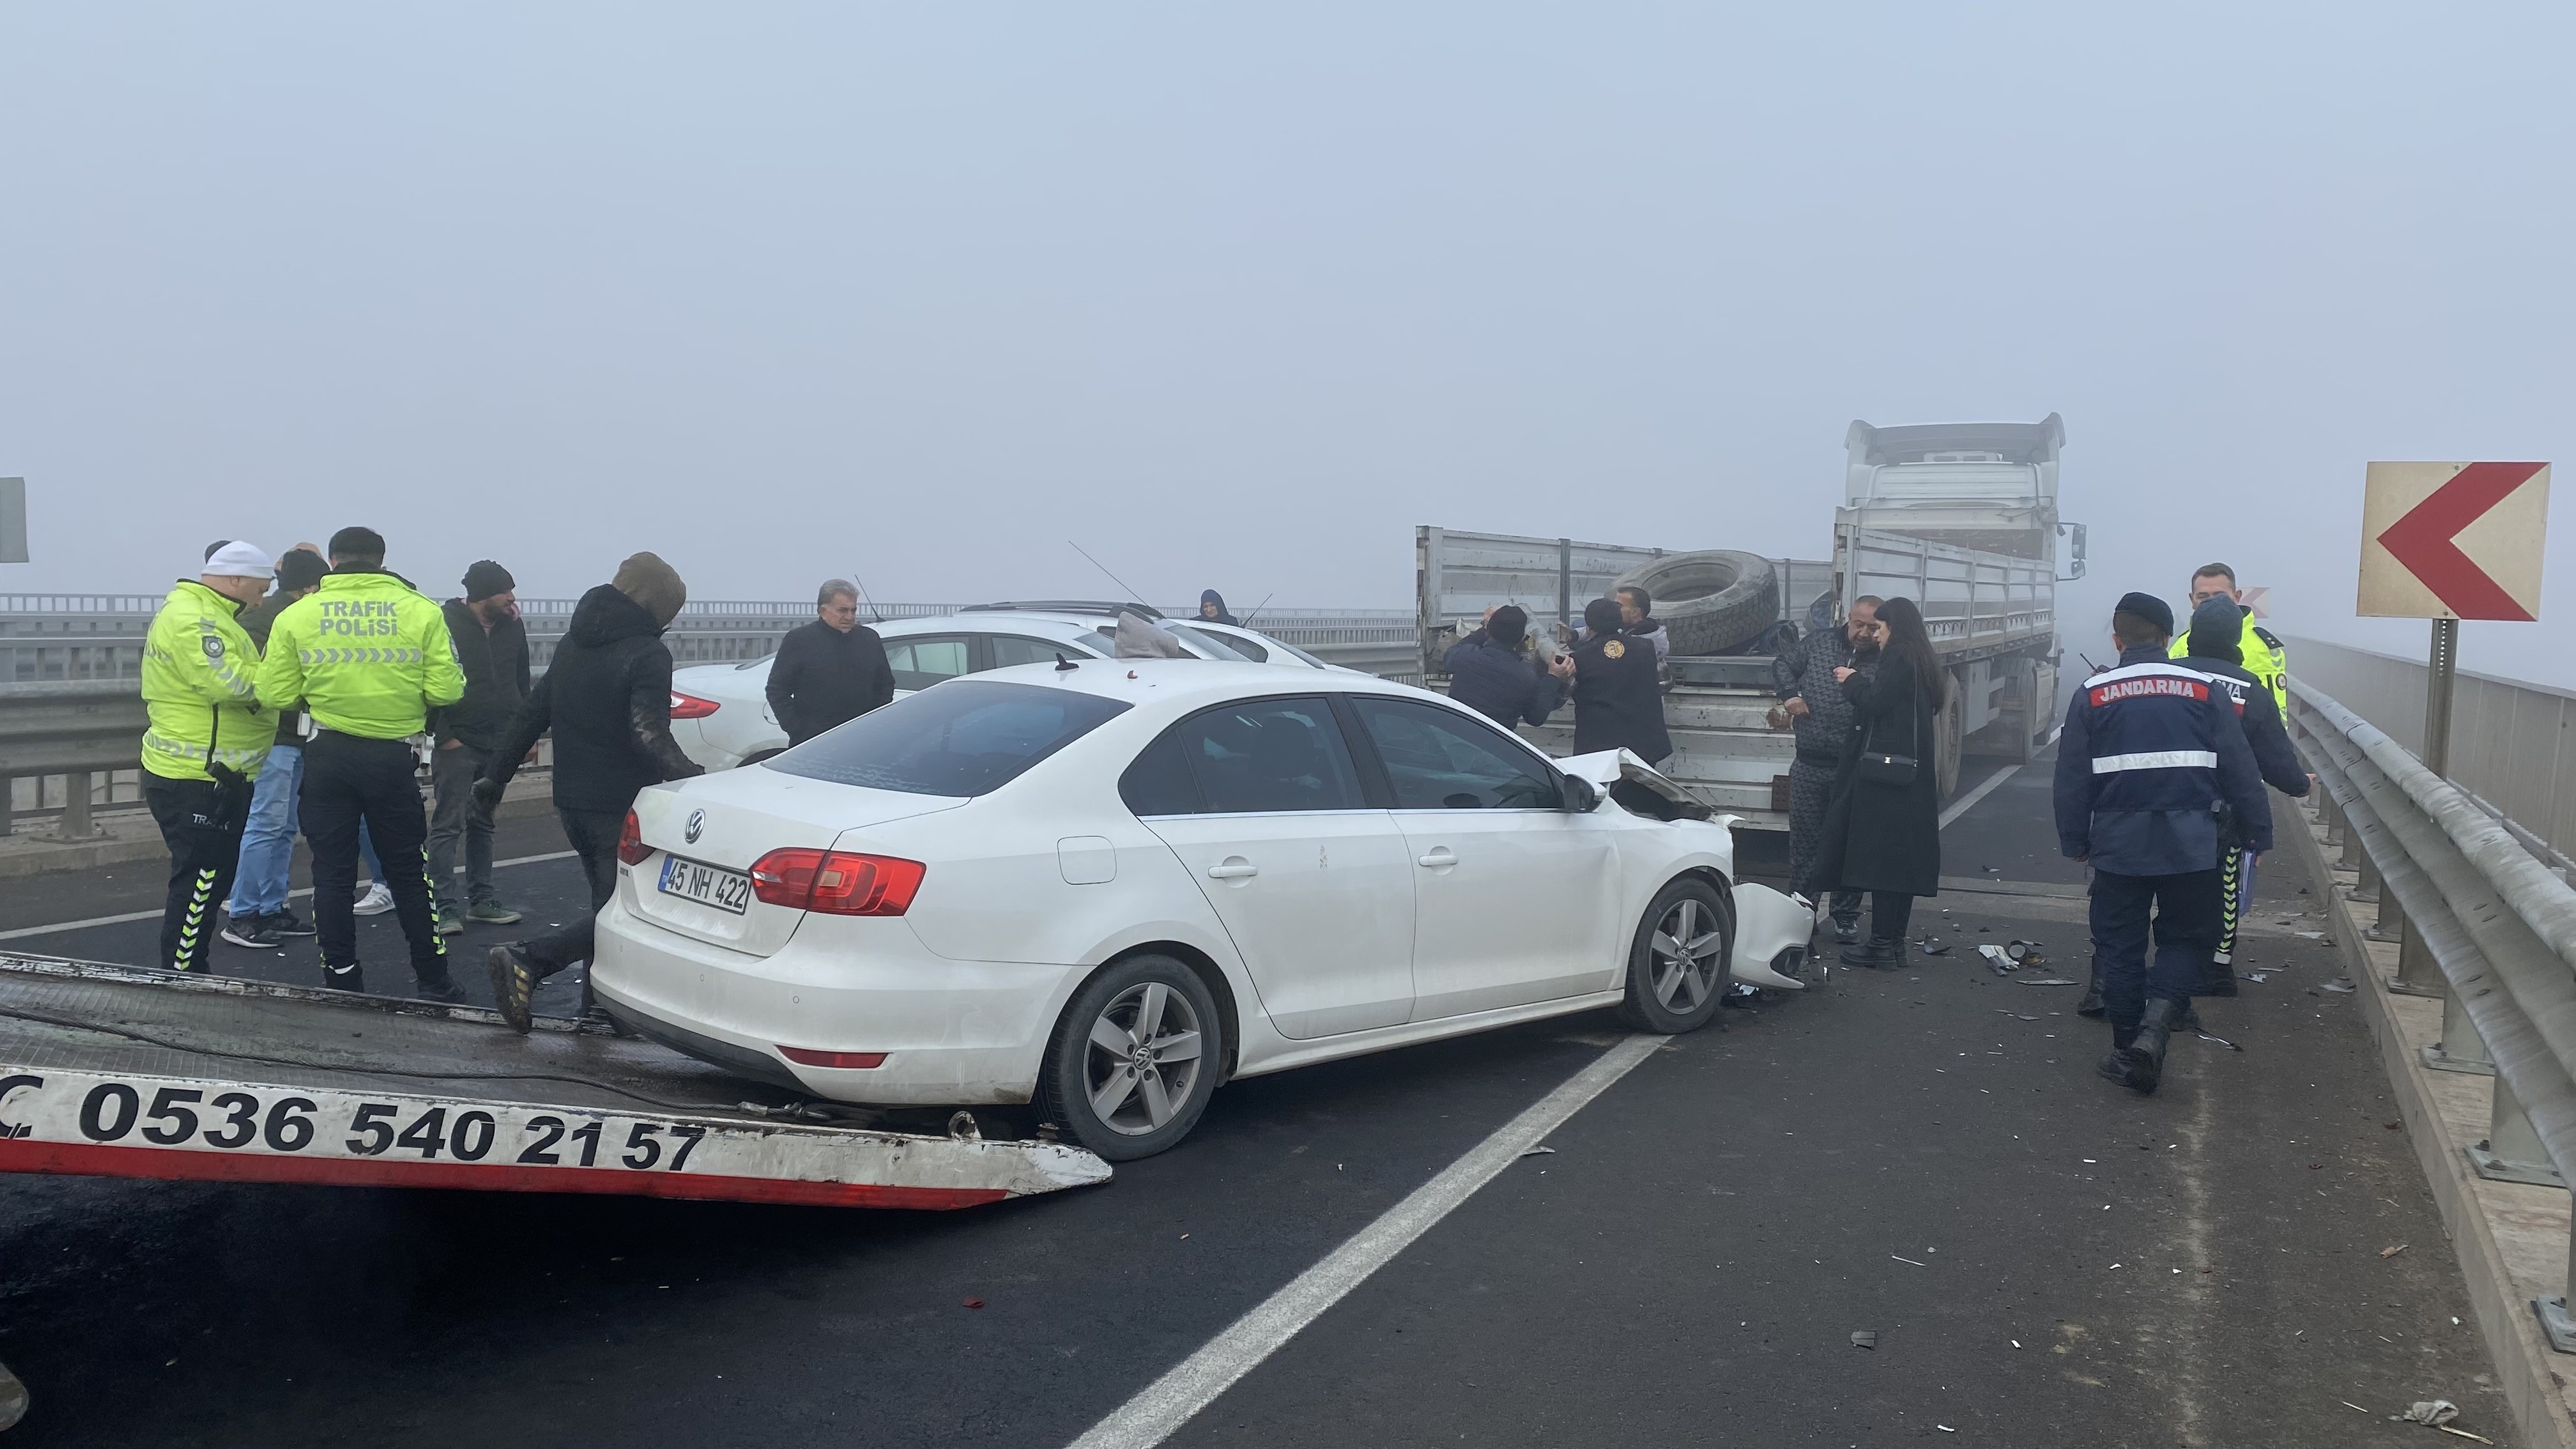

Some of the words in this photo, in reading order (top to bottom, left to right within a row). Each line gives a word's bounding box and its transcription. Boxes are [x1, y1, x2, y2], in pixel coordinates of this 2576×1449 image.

[2099, 679, 2195, 702] JANDARMA
[668, 861, 688, 891] 45
[687, 866, 714, 899] NH
[715, 875, 747, 909] 422
[79, 1083, 318, 1151] 0536
[345, 1103, 495, 1162] 540
[516, 1116, 602, 1167] 21
[622, 1123, 706, 1172] 57
